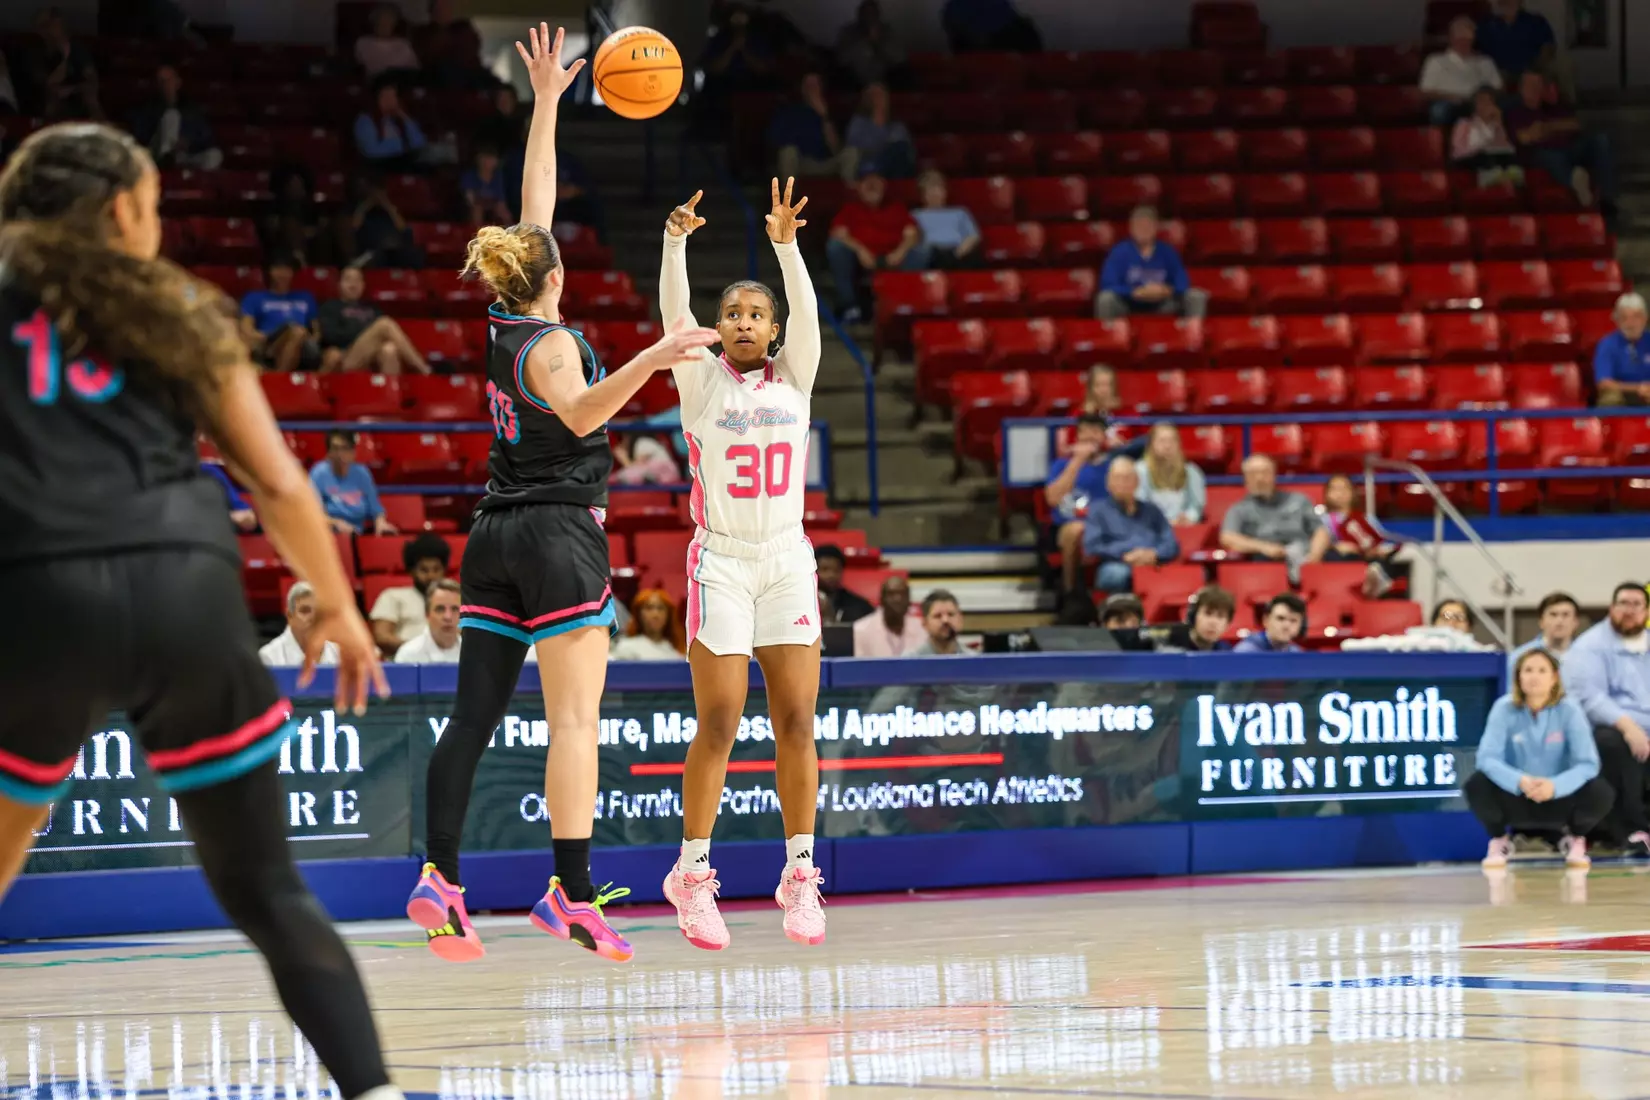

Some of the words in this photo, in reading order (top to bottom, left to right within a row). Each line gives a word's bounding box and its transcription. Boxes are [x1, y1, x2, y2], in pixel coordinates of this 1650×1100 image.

[715, 409, 750, 436] Lady
[725, 441, 793, 499] 30
[843, 705, 976, 746] Appliance
[979, 701, 1154, 740] Headquarters
[1197, 695, 1306, 746] Ivan
[1318, 686, 1459, 744] Smith
[1200, 753, 1457, 791] FURNITURE
[608, 786, 684, 818] Furnitu
[717, 784, 782, 815] Partn
[832, 781, 936, 811] Louisiana
[938, 778, 989, 806] Tech
[991, 774, 1084, 804] Athletics
